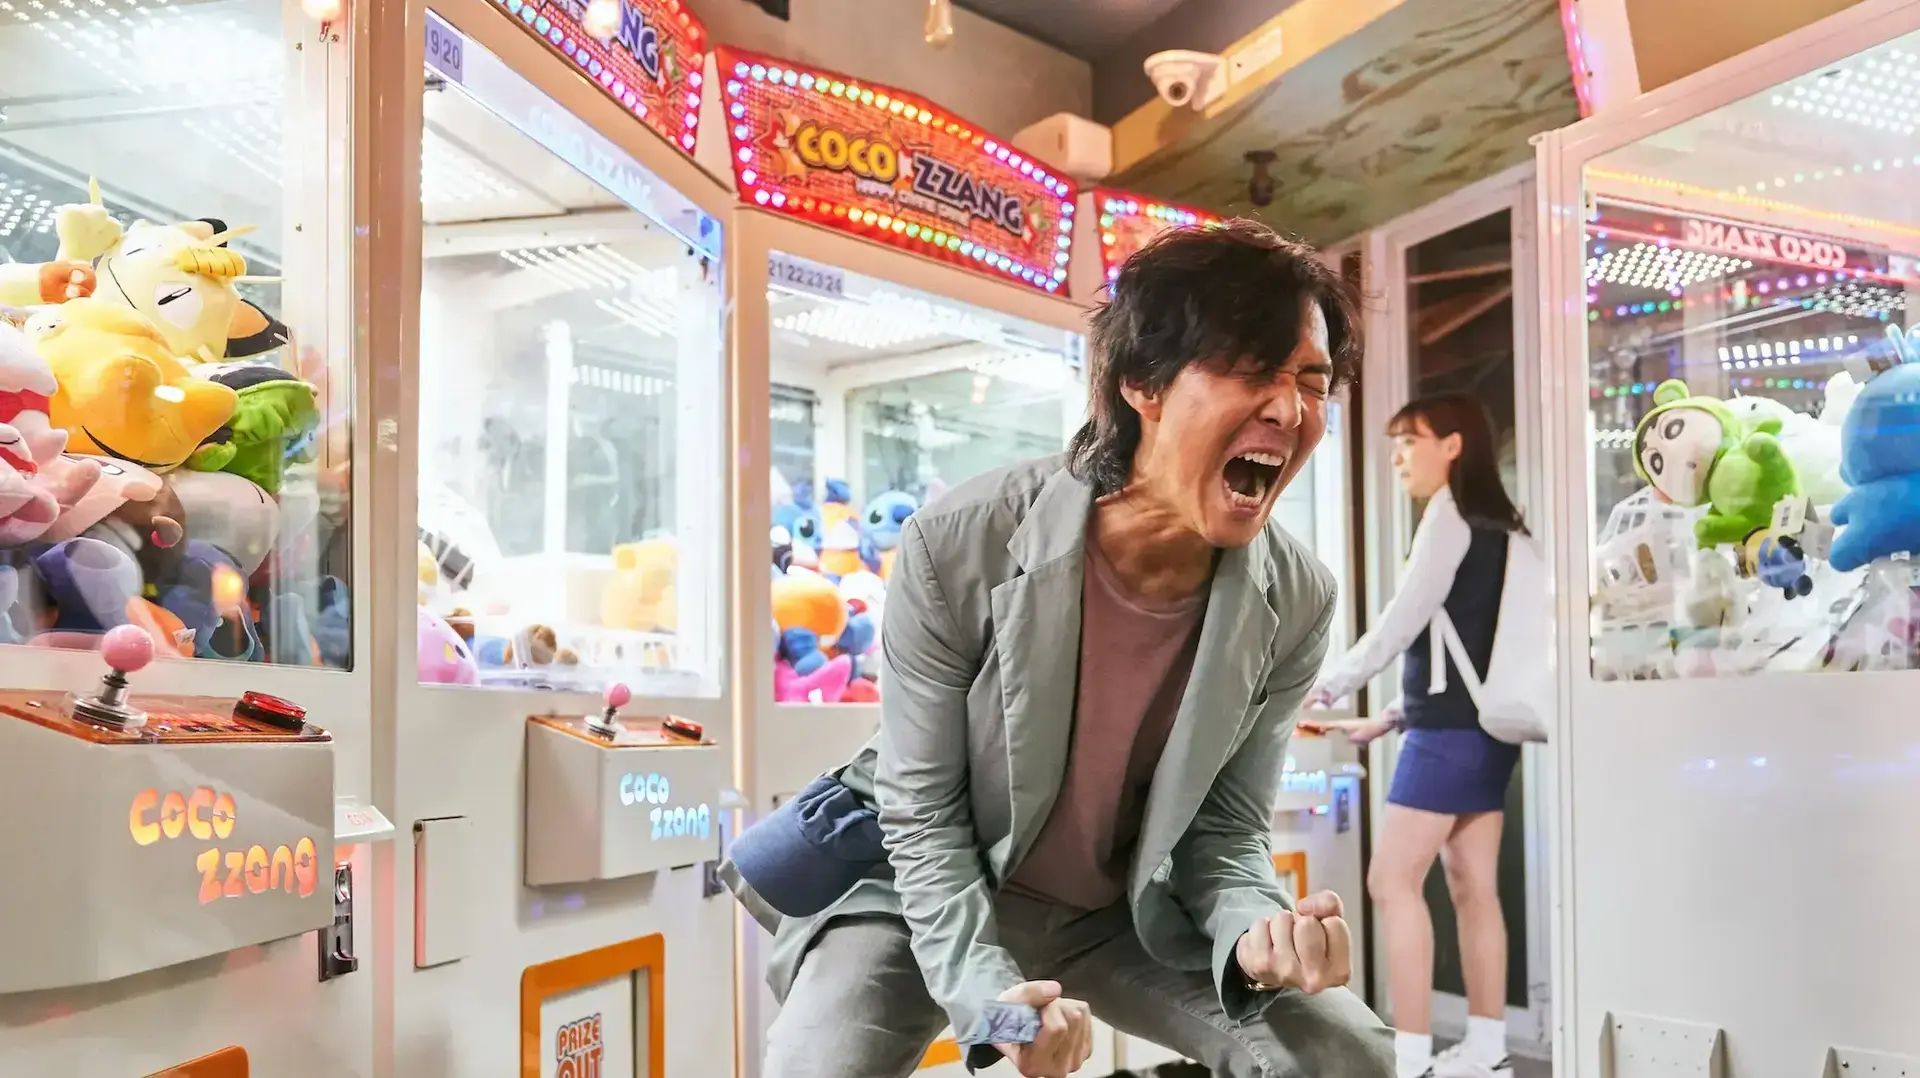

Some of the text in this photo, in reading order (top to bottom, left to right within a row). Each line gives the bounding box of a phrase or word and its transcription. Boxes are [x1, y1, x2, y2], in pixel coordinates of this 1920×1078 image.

[443, 38, 461, 70] 20
[796, 122, 898, 183] COCO
[912, 152, 1024, 236] ZZANG
[787, 264, 804, 285] 22
[557, 1013, 602, 1062] PRIZE
